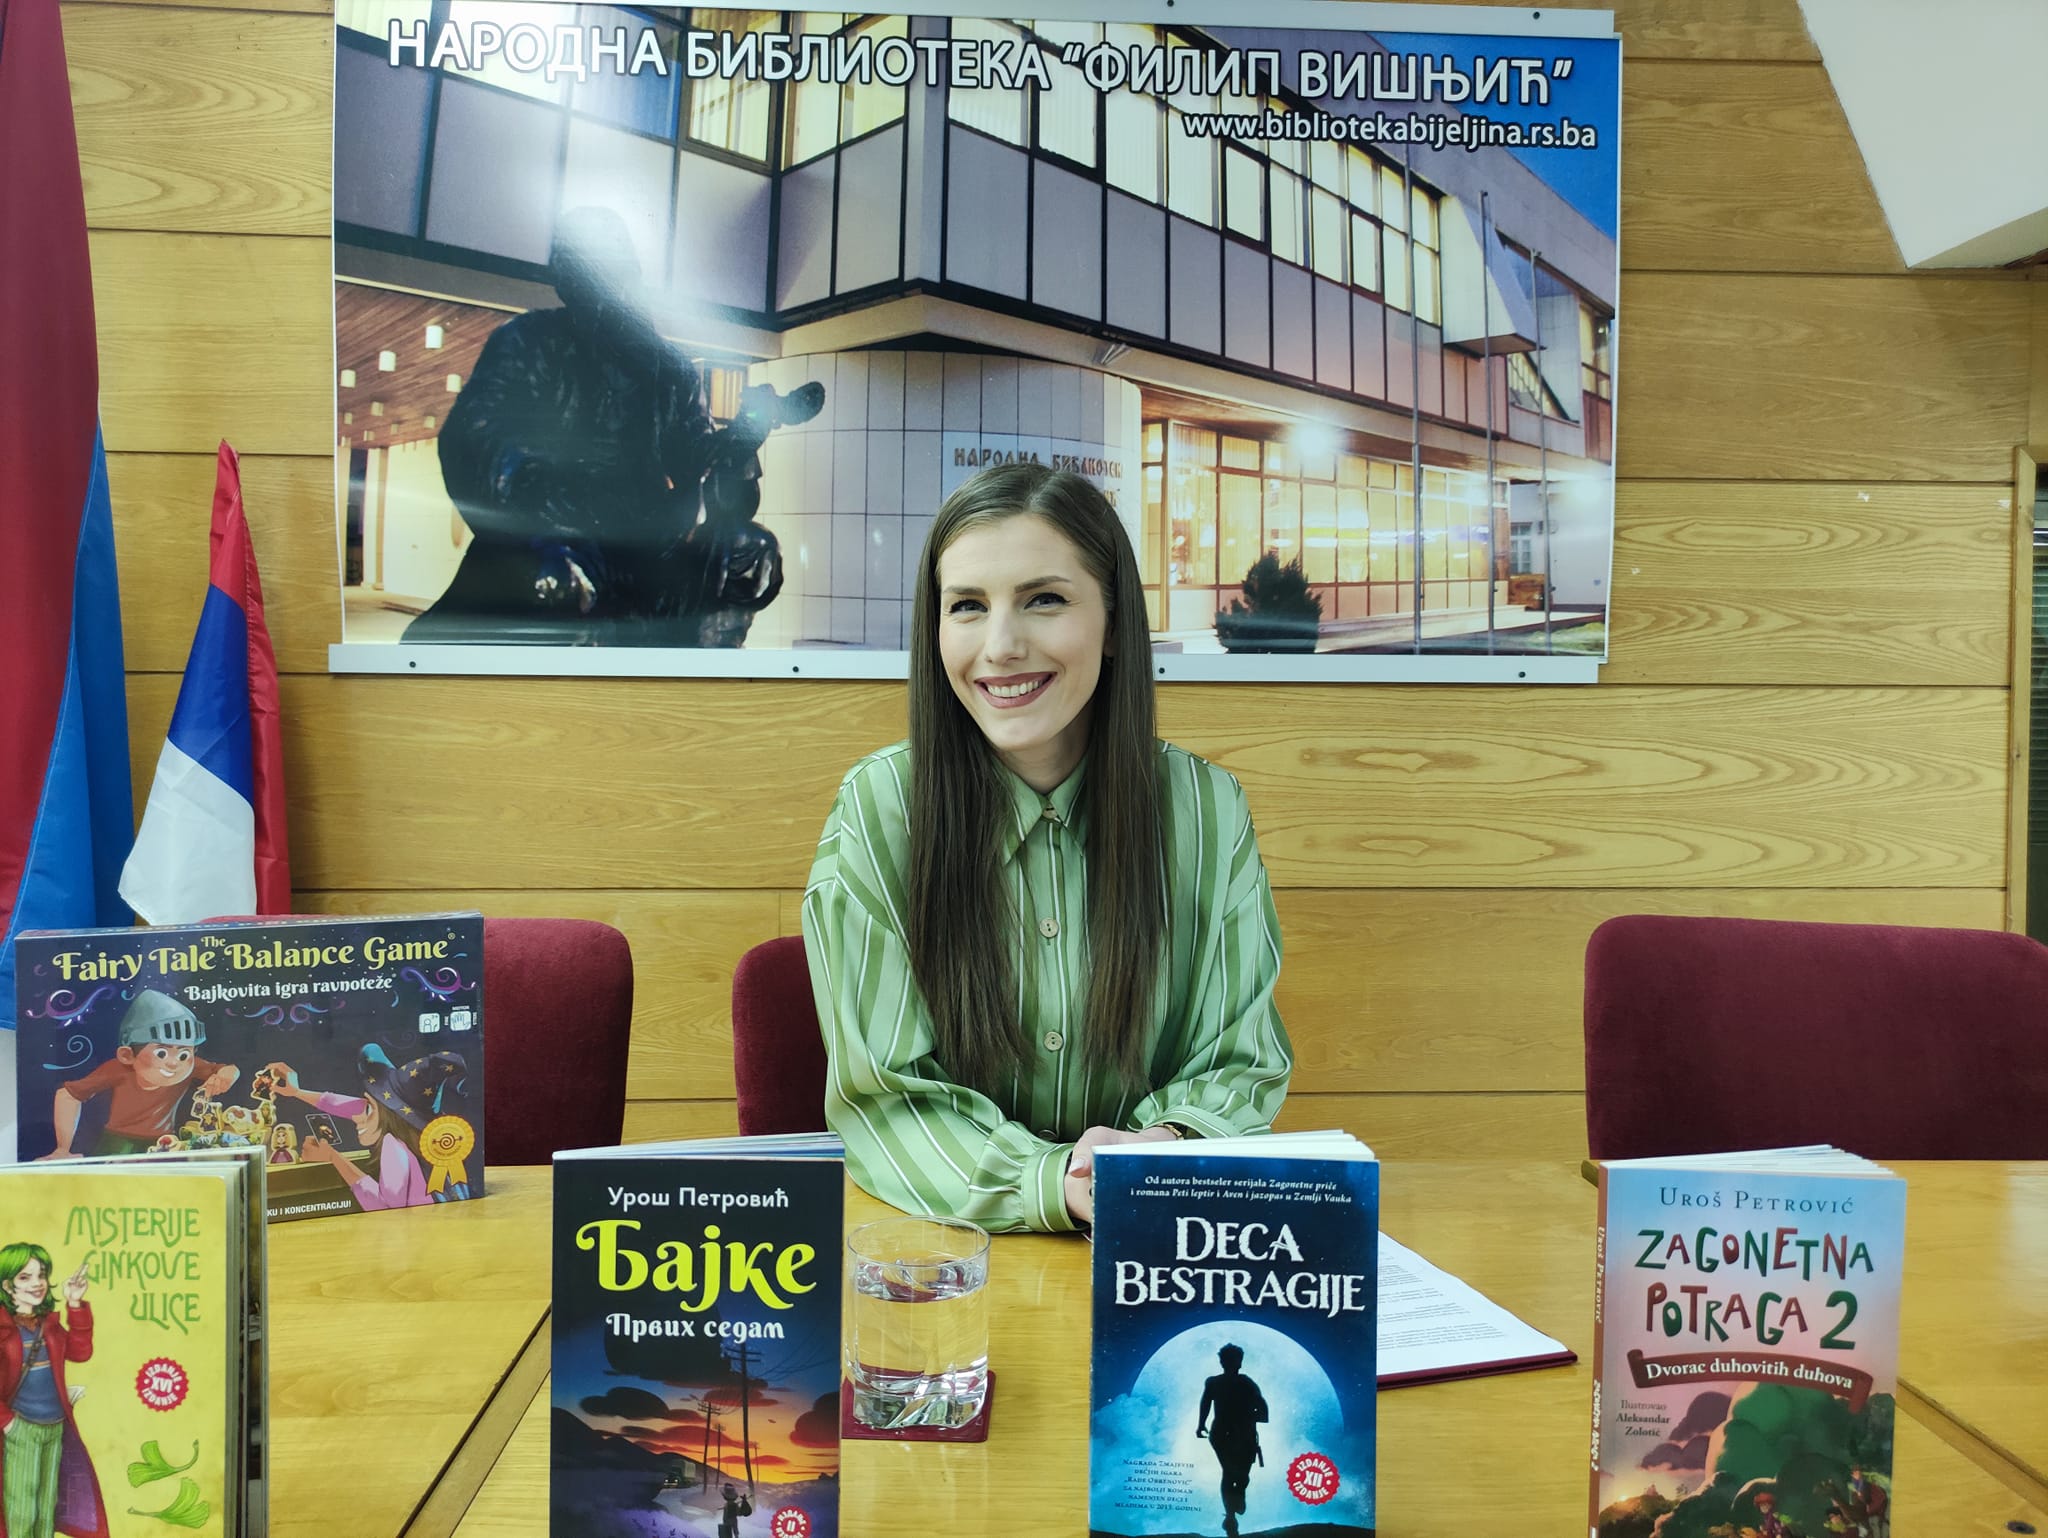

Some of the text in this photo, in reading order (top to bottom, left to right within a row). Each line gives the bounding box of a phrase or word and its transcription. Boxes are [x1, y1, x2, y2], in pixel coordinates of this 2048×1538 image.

[387, 19, 668, 83] НАРОДНА
[685, 31, 1052, 92] БИБЛИОТЕКА
[1183, 109, 1597, 150] www.bibliotekabijeljina.rs.ba
[200, 936, 226, 948] The
[53, 952, 143, 983] Fairy
[149, 946, 216, 974] Tale
[224, 940, 355, 970] Balance
[184, 975, 393, 1004] Bajkovita igra ravnoteže
[607, 1186, 789, 1213] Урош Петровић
[1135, 1189, 1170, 1197] romana
[1172, 1188, 1189, 1197] Peti
[1191, 1188, 1214, 1199] leptir
[1222, 1190, 1244, 1199] Aven
[1249, 1191, 1284, 1202] jazopas
[1294, 1192, 1322, 1203] Zemlji
[1145, 1175, 1159, 1185] Od
[1161, 1177, 1190, 1186] autora
[1192, 1176, 1232, 1187] bestseler
[1234, 1178, 1267, 1190] serijala
[1269, 1179, 1314, 1192] Zagonetne
[1659, 1187, 1855, 1214] UROŠ PETROVIĆ
[284, 1199, 352, 1215] KONCENTRACIJU!
[64, 1205, 201, 1249] MISTERIJE
[1175, 1216, 1305, 1263] DECA
[84, 1250, 201, 1291] GINKOVE
[576, 1219, 817, 1313] Бајке
[1635, 1226, 1874, 1281] ZAGONETNA
[1115, 1260, 1366, 1318] BESTRAGIJE
[129, 1292, 201, 1335] ULICE
[606, 1313, 785, 1344] Првих седам
[1646, 1282, 1859, 1350] POTRAGA 2
[1645, 1358, 1855, 1389] Dvorac duhovitih duhova
[1615, 1413, 1670, 1424] Aleksandar
[1303, 1470, 1324, 1488] XII
